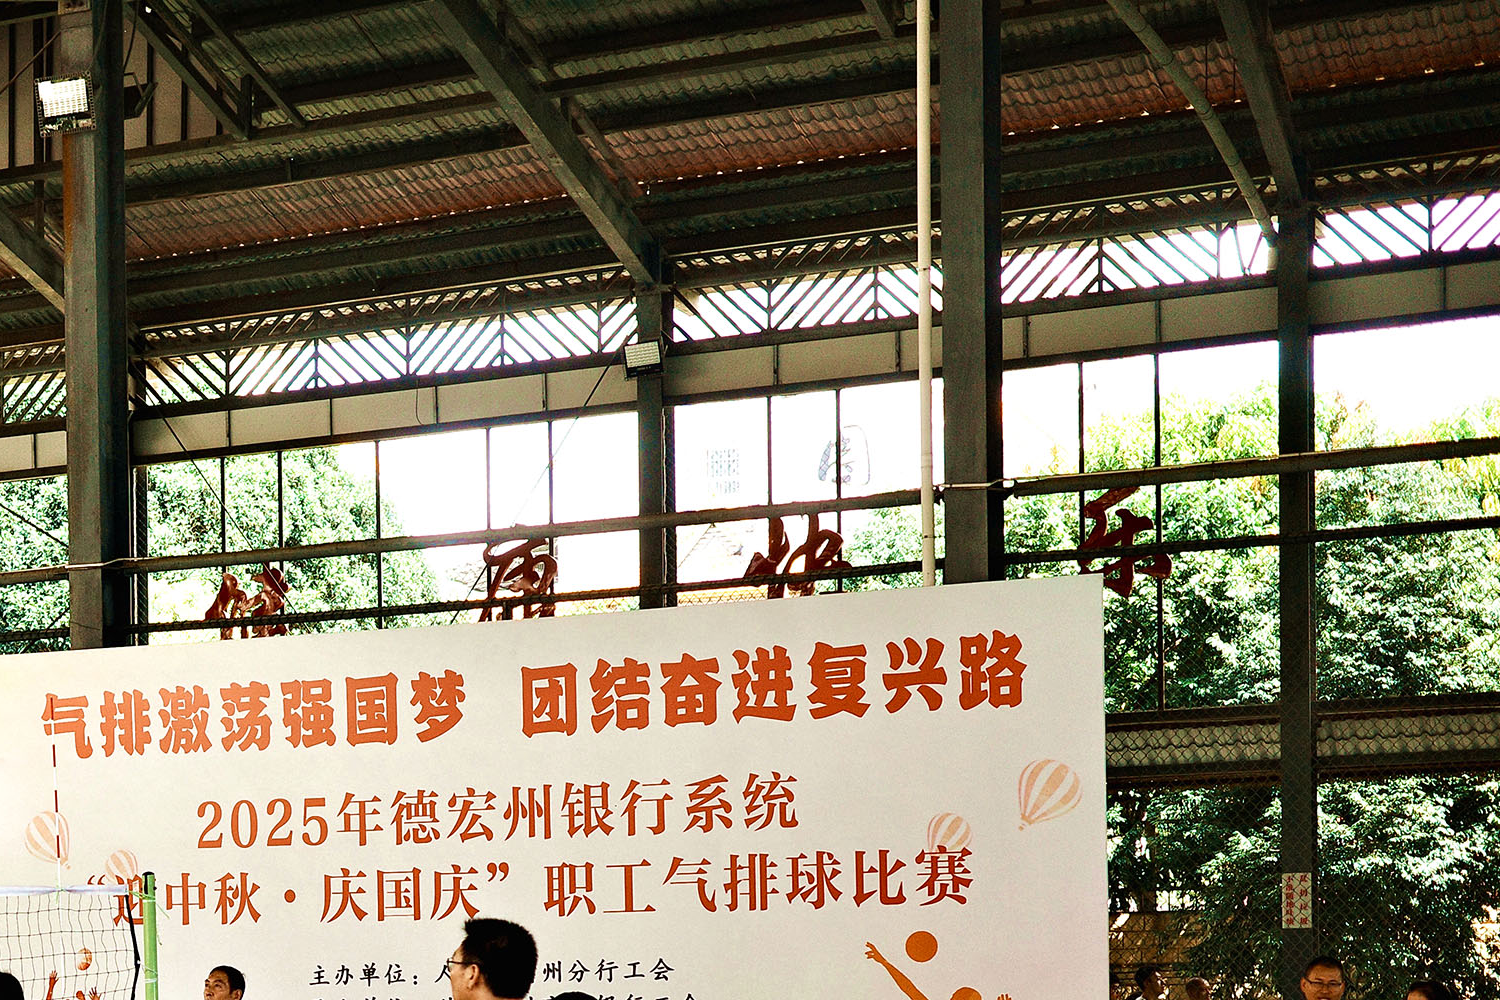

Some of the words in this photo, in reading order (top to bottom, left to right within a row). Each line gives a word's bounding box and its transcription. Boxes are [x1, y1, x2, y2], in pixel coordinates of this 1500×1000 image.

[43, 669, 466, 759] 气排激荡强国梦
[520, 629, 1028, 739] 团结奋进复兴路
[197, 771, 799, 849] 2025年德宏州银行系统
